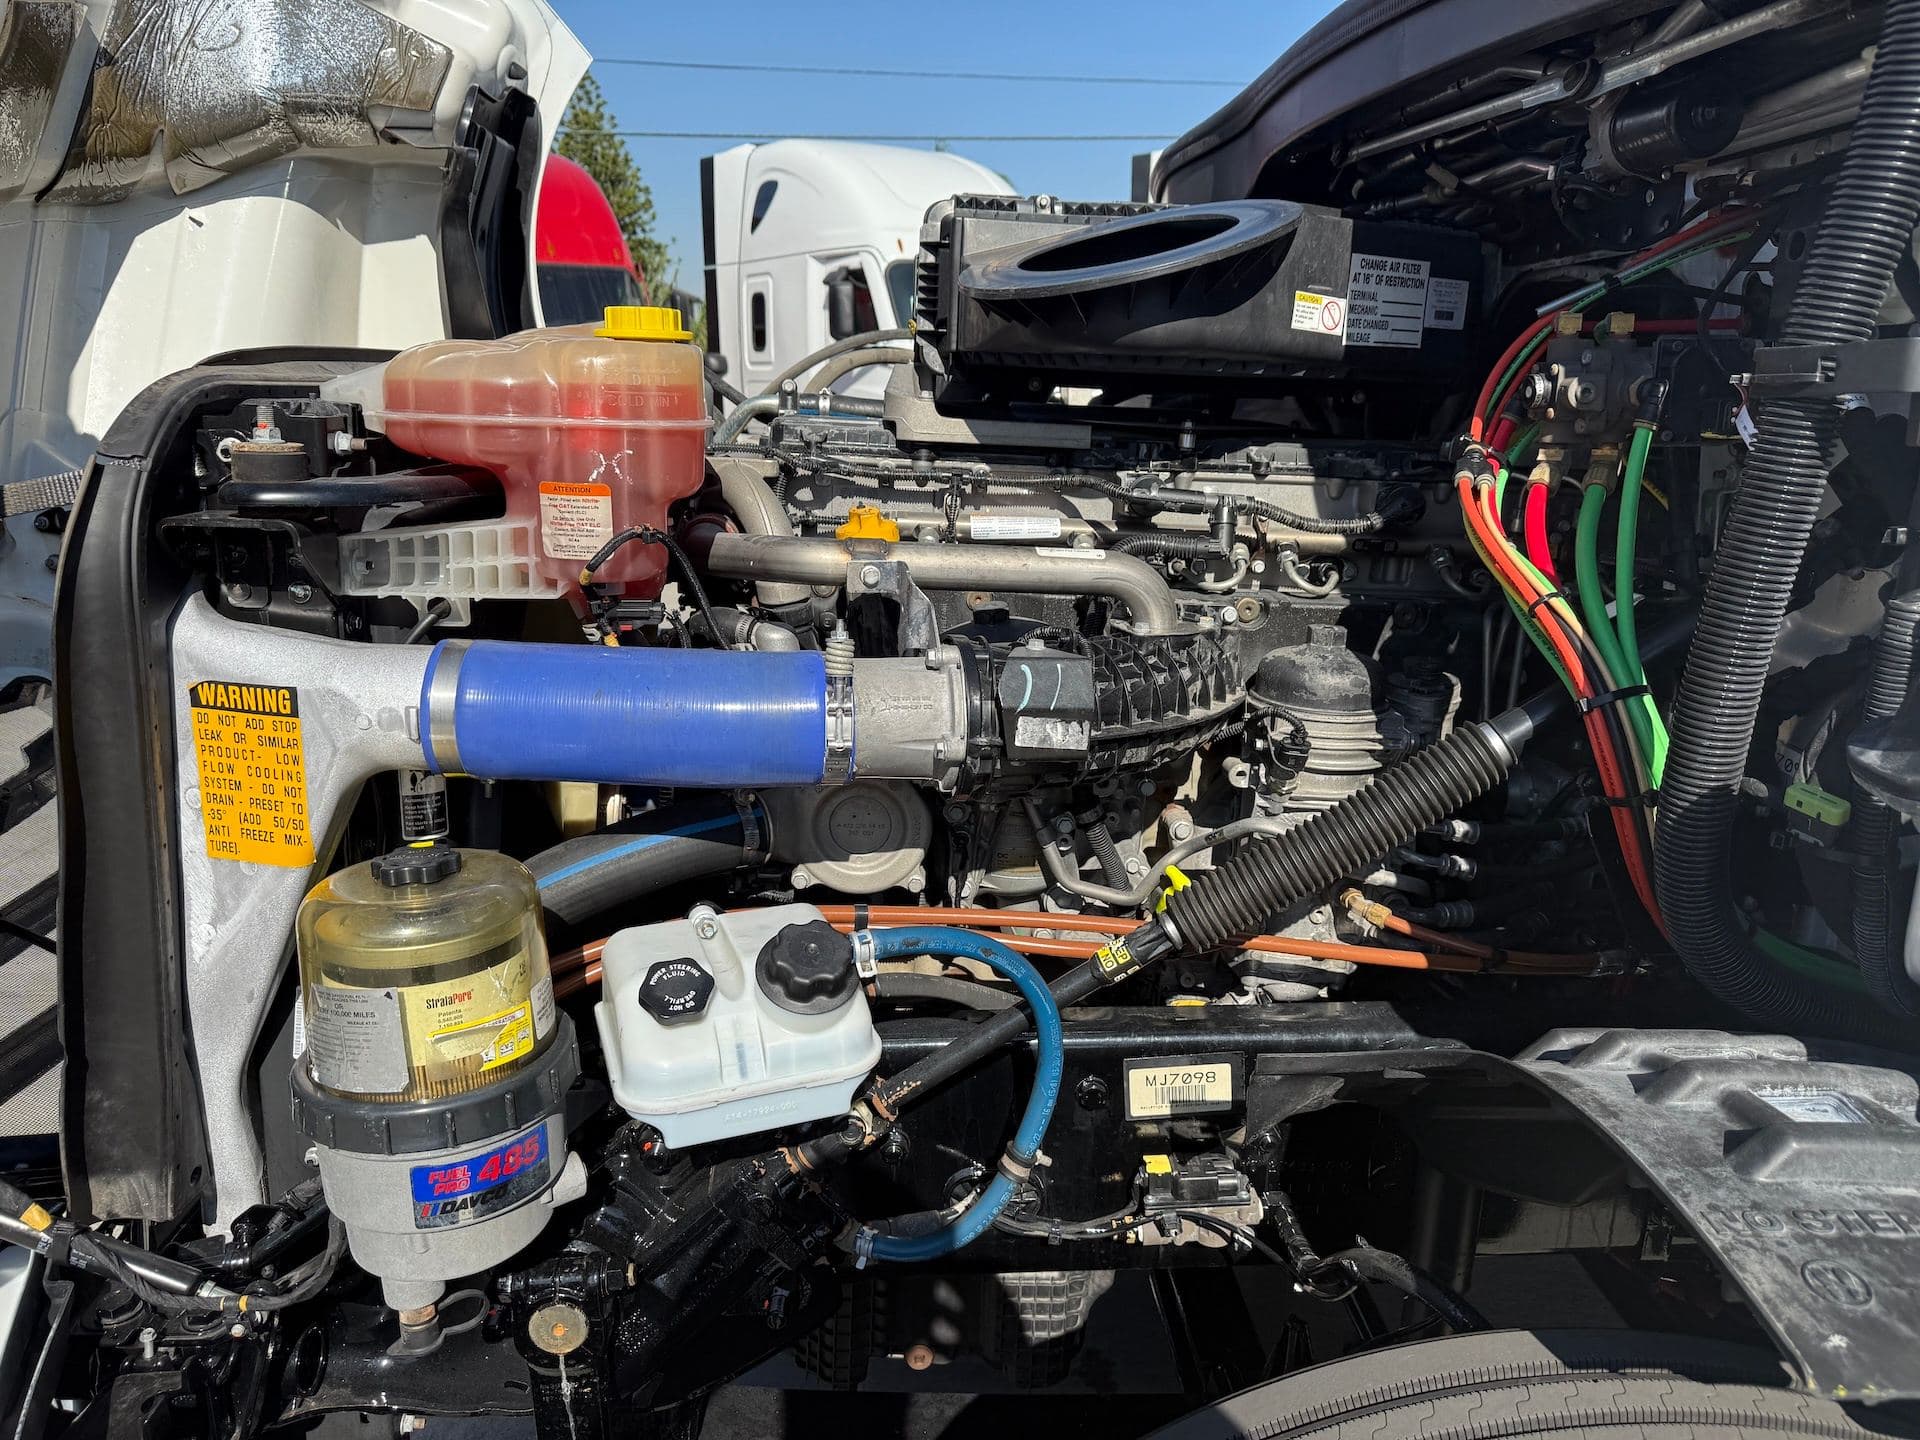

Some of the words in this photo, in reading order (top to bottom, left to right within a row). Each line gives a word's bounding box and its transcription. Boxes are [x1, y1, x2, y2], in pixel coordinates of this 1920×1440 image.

[1360, 258, 1388, 272] CHANGE
[1389, 261, 1401, 272] AIR
[1402, 262, 1422, 274] FILTER
[1352, 272, 1362, 284] AT
[1375, 274, 1384, 286] OF
[1385, 276, 1425, 289] RESTRICTION
[1351, 290, 1378, 302] TERMINAL
[1348, 304, 1378, 316] MECHANIC
[1347, 318, 1362, 329] DATE
[1363, 319, 1389, 330] CHANGED
[1346, 332, 1371, 343] MILEAGE
[554, 486, 591, 494] ATTENTION
[198, 682, 291, 714] WARNING
[197, 712, 209, 724] DO
[218, 714, 236, 728] NOT
[246, 717, 264, 731] ADD
[272, 720, 297, 734] STOP
[199, 728, 222, 742] LEAK
[234, 732, 246, 744] OR
[258, 735, 299, 750] SIMILAR
[276, 752, 300, 766] LOW
[203, 760, 234, 775] FLOW
[246, 765, 302, 782] COOLING
[204, 776, 242, 792] SYSTEM
[262, 783, 274, 795] DO
[284, 787, 302, 799] NOT
[206, 792, 234, 806] DRAIN
[250, 797, 284, 813] PRESET
[292, 802, 304, 814] TO
[274, 816, 304, 831] 50/50
[208, 824, 230, 837] ANTI
[240, 828, 275, 843] FREEZE
[284, 834, 308, 846] MIX-
[650, 968, 667, 986] POWER
[669, 964, 701, 978] STEERING
[662, 970, 686, 980] FLUID
[426, 990, 472, 1010] StrataPore
[664, 990, 696, 1004] OVERFILL
[685, 1000, 696, 1008] DO
[330, 1010, 352, 1018] 100,000
[1145, 1072, 1216, 1087] MJ7098
[428, 1165, 471, 1184] FUEL
[479, 1135, 539, 1181] 485
[434, 1178, 470, 1196] PRO
[440, 1182, 509, 1214] DAVCO
[1699, 1208, 1785, 1236] NO
